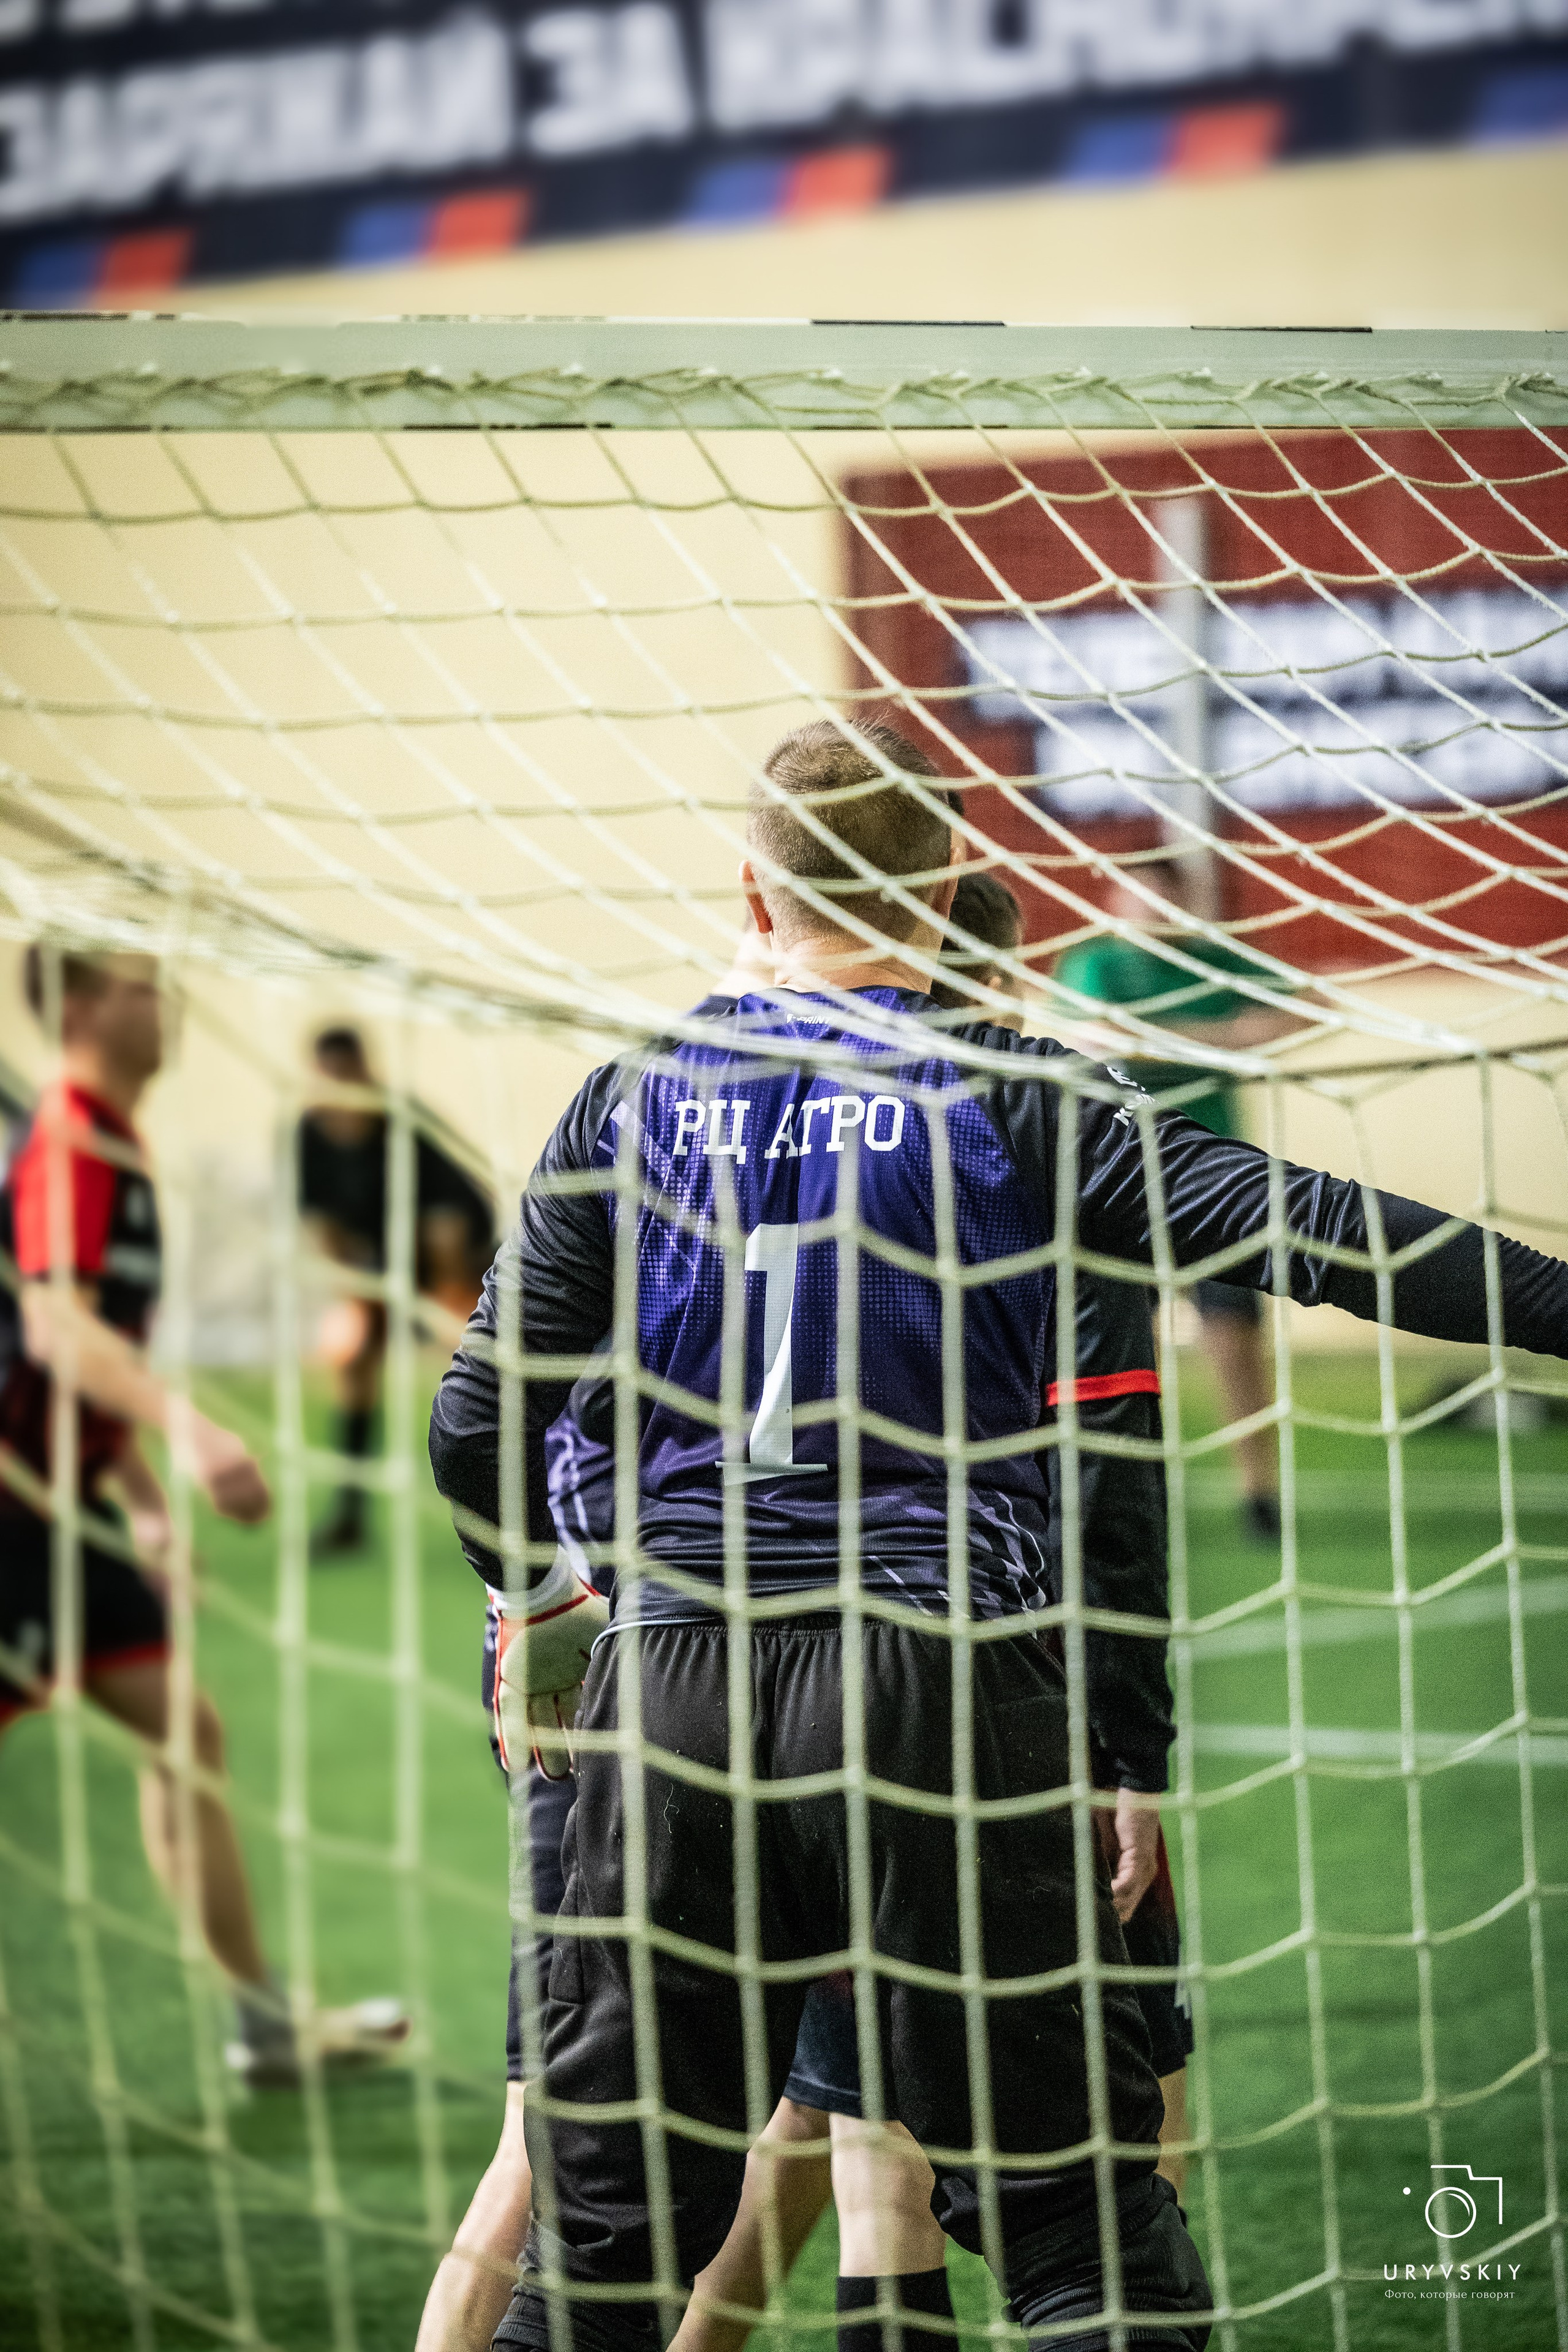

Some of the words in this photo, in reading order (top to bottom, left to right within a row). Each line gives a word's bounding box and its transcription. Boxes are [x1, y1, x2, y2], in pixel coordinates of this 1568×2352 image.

[673, 1099, 751, 1164] РЦ
[764, 1095, 905, 1159] АГРО
[715, 1223, 829, 1487] 1
